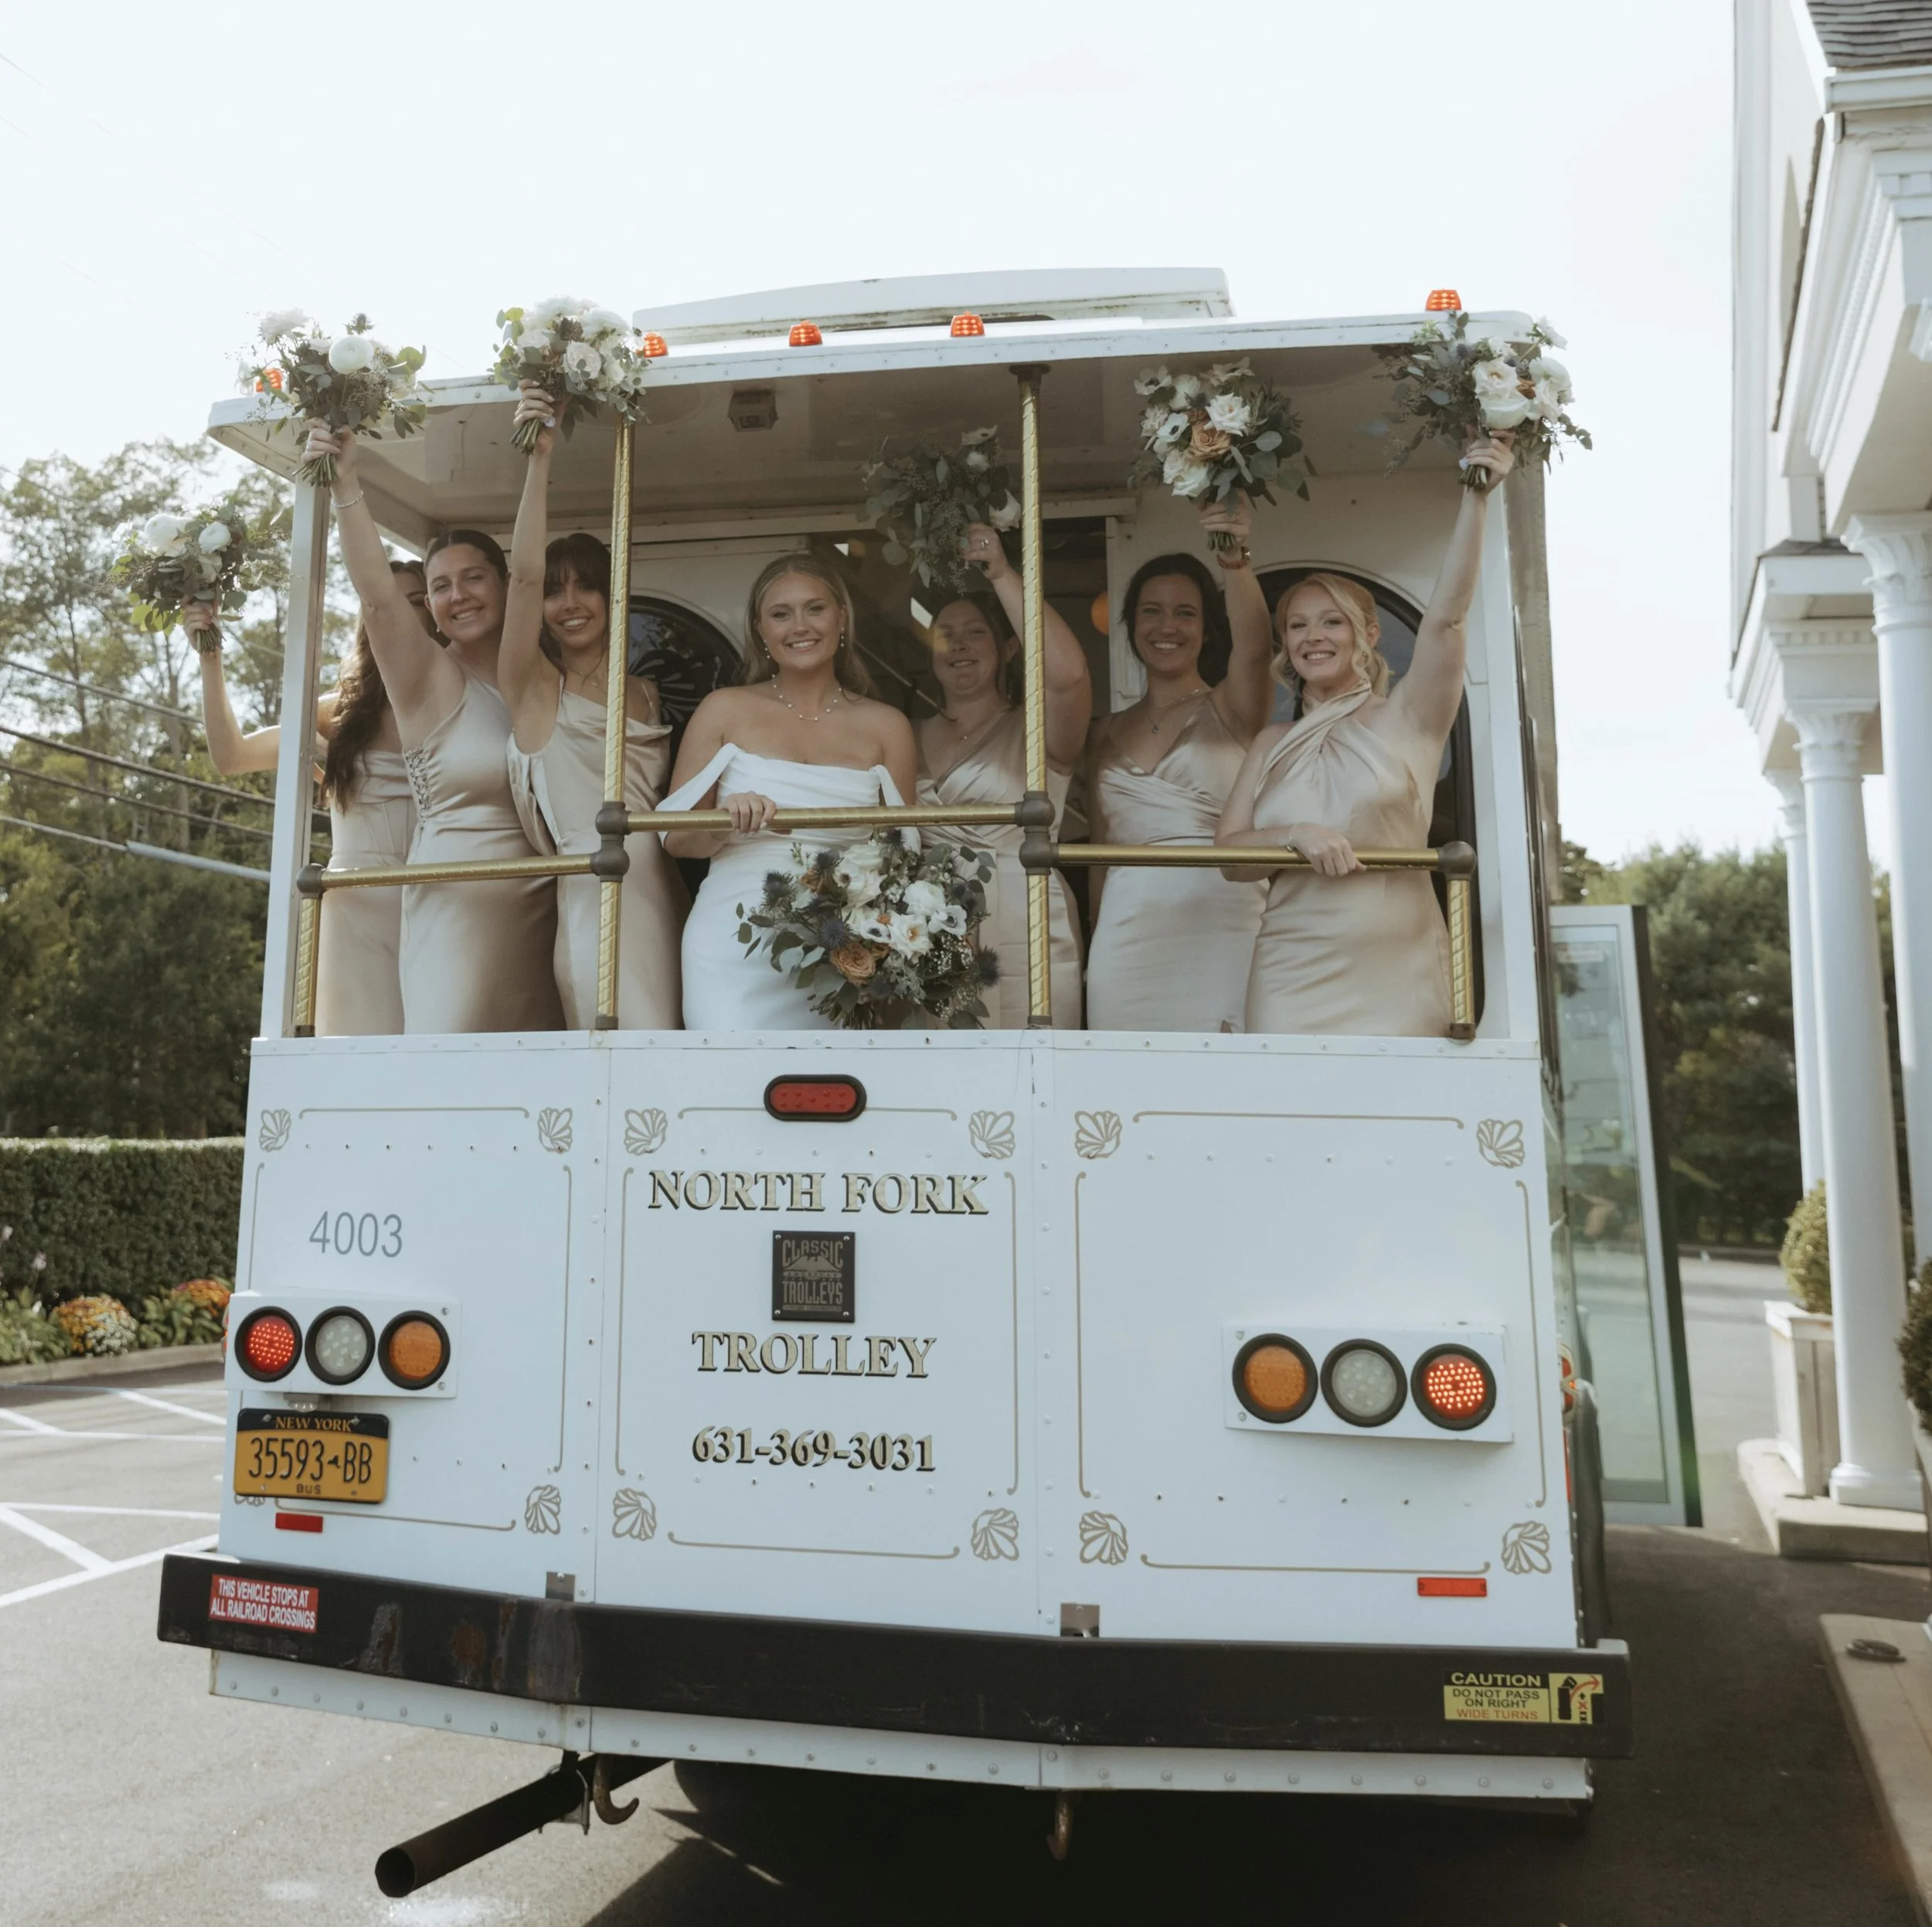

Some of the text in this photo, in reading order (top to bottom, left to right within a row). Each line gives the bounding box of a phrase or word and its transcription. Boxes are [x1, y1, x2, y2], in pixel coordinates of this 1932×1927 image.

[648, 1170, 990, 1215] NORTH FORK
[309, 1211, 403, 1258] 4003
[782, 1239, 844, 1269] CLASSIC
[782, 1280, 843, 1305] TROLLEYS
[691, 1331, 937, 1378] TROLLEY
[275, 1416, 351, 1433] NEW YORK
[248, 1437, 372, 1484] 35593 BB
[692, 1426, 936, 1472] 631-369-3031
[296, 1483, 321, 1494] BUS
[219, 1579, 309, 1608] THIS VEHICLE STOPS AT
[210, 1597, 316, 1630] ALL RAILROAD CROSSINGS
[1451, 1672, 1541, 1687] CAUTION
[1452, 1688, 1540, 1701] DO NOT PASS
[1464, 1698, 1527, 1709] ON RIGHT
[1456, 1709, 1539, 1721] WIDE TURNS
